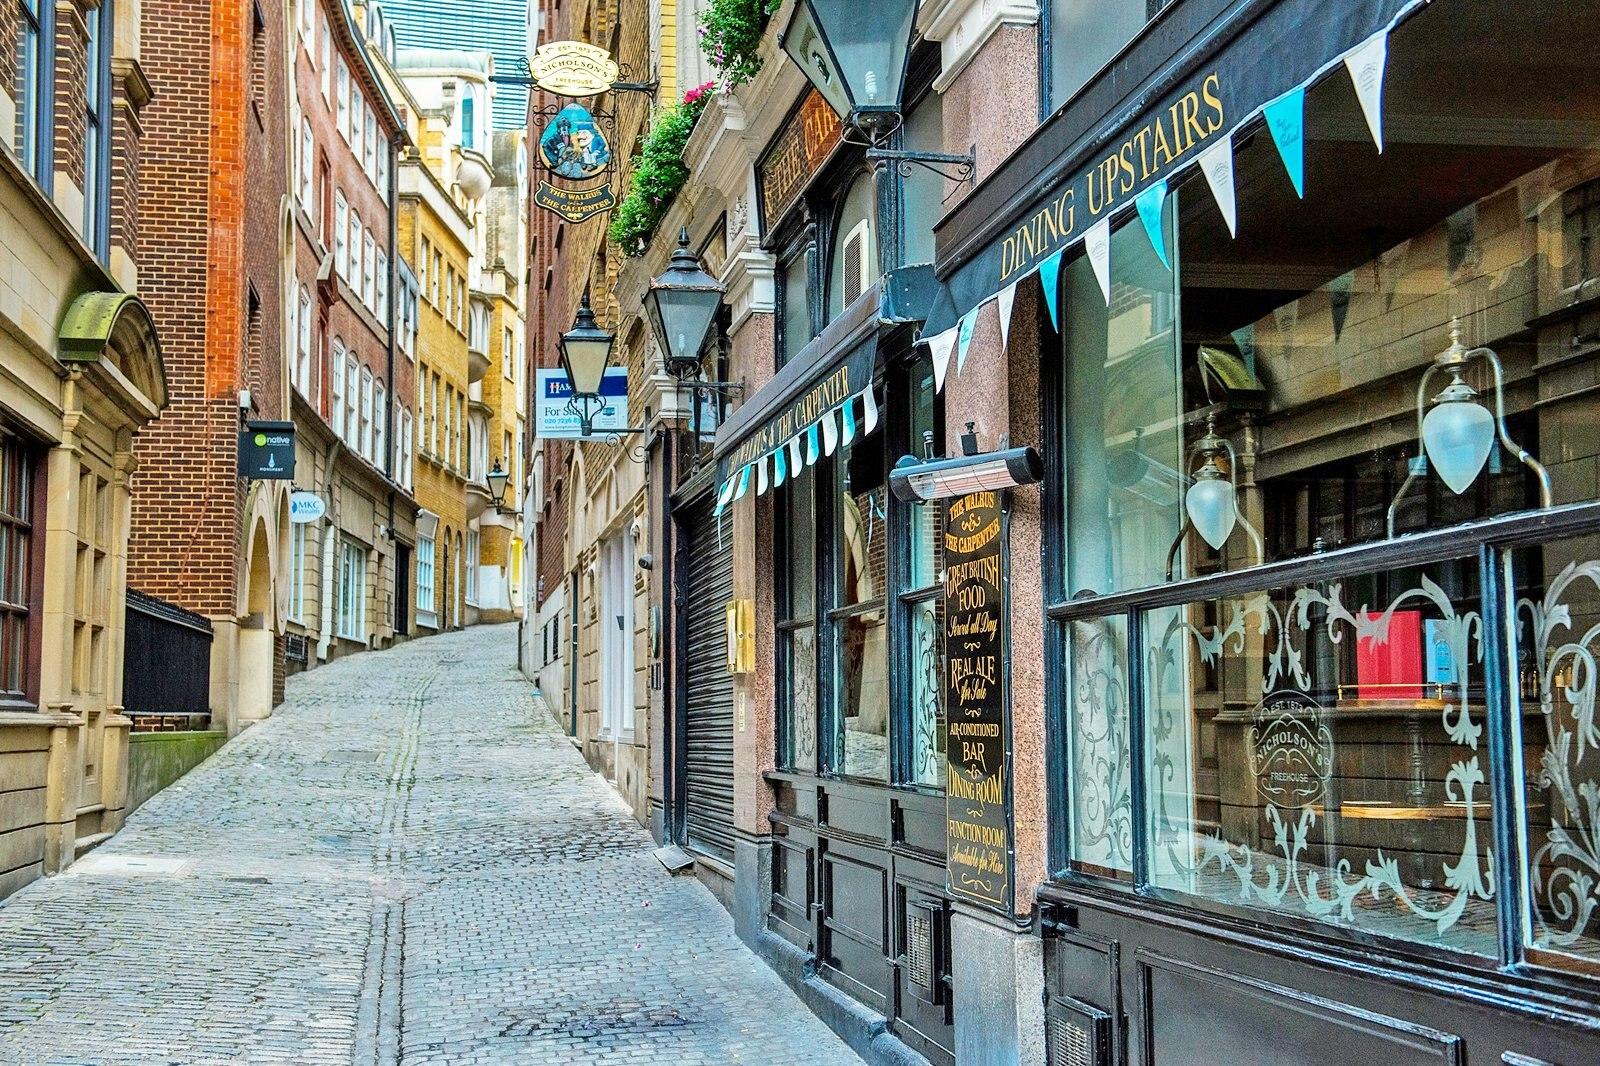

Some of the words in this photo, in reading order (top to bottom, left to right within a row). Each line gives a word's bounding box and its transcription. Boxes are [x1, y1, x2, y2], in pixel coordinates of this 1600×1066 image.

[540, 60, 608, 78] NICHOLSON'S
[1000, 188, 1075, 282] DINING
[1086, 71, 1225, 215] UPSTAIRS
[542, 196, 560, 208] THE
[549, 187, 567, 199] THE
[568, 189, 602, 200] WALRUS
[544, 406, 561, 416] For
[777, 409, 794, 445] THE
[795, 365, 849, 430] CARPENTER
[950, 498, 965, 522] THE
[964, 491, 994, 511] WALRUS
[945, 532, 958, 552] THE
[958, 517, 1001, 553] CARPENTER
[946, 563, 969, 599] GREAT
[969, 554, 1000, 591] BRITISH
[959, 584, 986, 611] FOOD
[947, 614, 971, 638] Served
[980, 611, 998, 642] Day
[951, 657, 974, 694] REAL
[975, 655, 996, 685] ALE
[960, 679, 971, 706] for
[1286, 700, 1304, 713] 1873
[949, 722, 1000, 740] AIR-CONDITIONED
[962, 741, 987, 772] BAR
[1257, 731, 1323, 766] NICHOLSON'S
[948, 760, 975, 800] DINING
[975, 765, 1003, 810] ROOM
[1270, 771, 1309, 783] FREEHOUSE
[949, 820, 982, 843] FUNCTION
[982, 826, 1004, 849] ROOM
[949, 843, 979, 868] Available
[977, 849, 988, 876] for
[987, 850, 1004, 876] Hire
